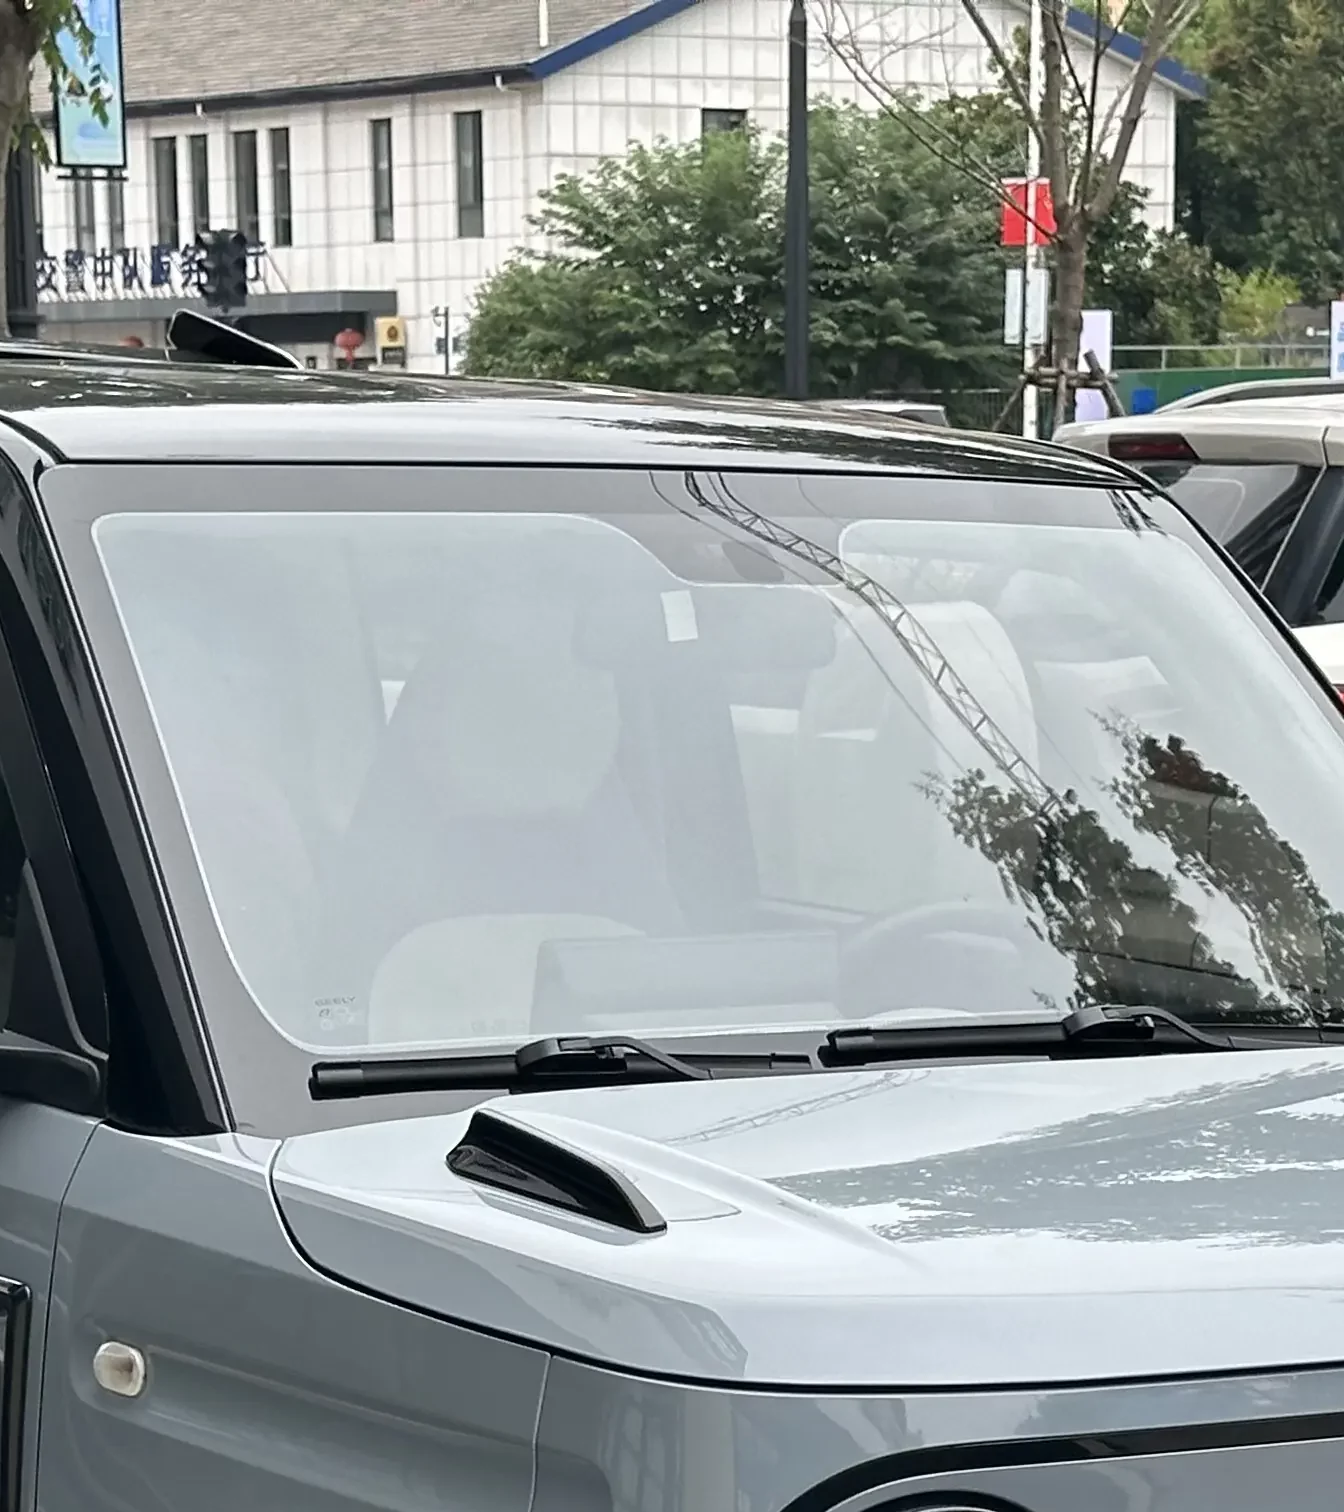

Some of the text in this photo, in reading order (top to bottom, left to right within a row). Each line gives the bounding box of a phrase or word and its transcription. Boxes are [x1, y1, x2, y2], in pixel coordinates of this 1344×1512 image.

[36, 244, 266, 293] 交警中队服务厅
